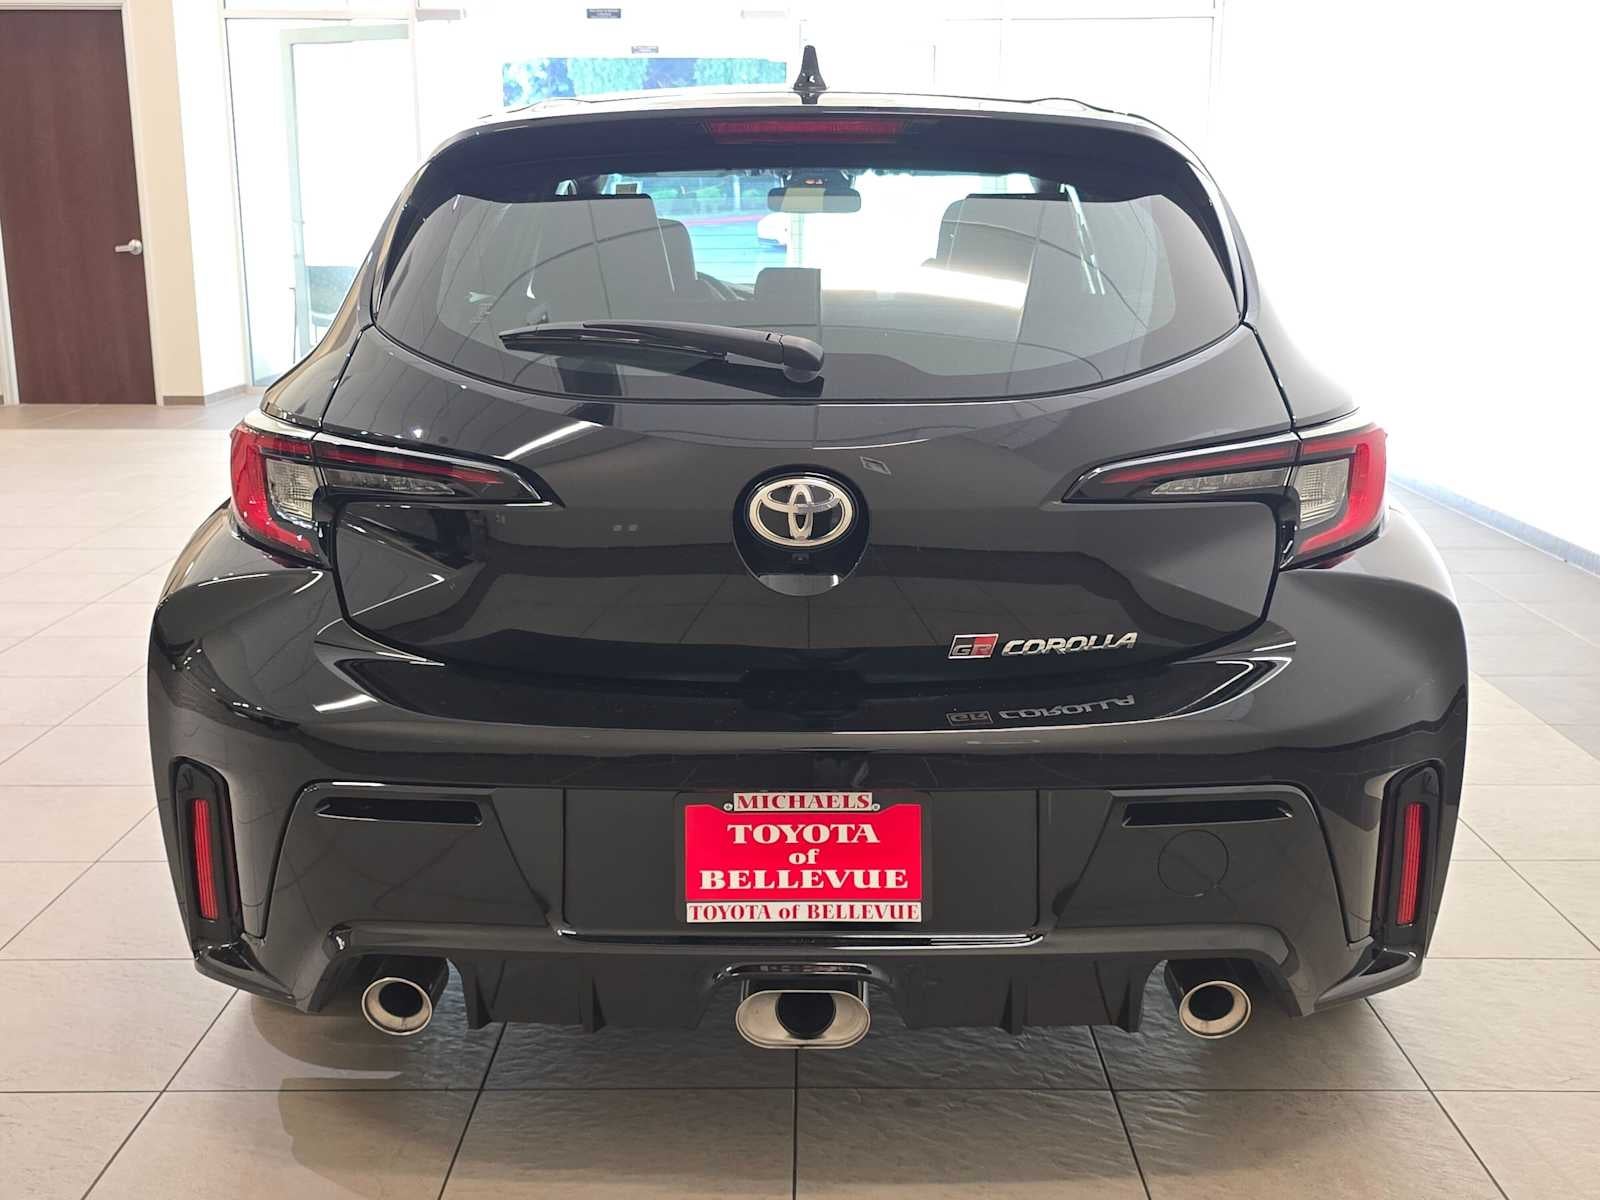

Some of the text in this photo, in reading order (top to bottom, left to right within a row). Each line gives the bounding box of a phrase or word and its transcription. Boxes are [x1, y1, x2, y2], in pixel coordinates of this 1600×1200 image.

[951, 631, 1138, 657] GR COROLLA
[736, 794, 871, 810] MICHAELS
[727, 823, 881, 844] TOYOTA
[788, 848, 821, 865] of
[699, 869, 909, 890] BELLEVUE
[689, 904, 920, 921] TOYOTA of BELLEVUE
